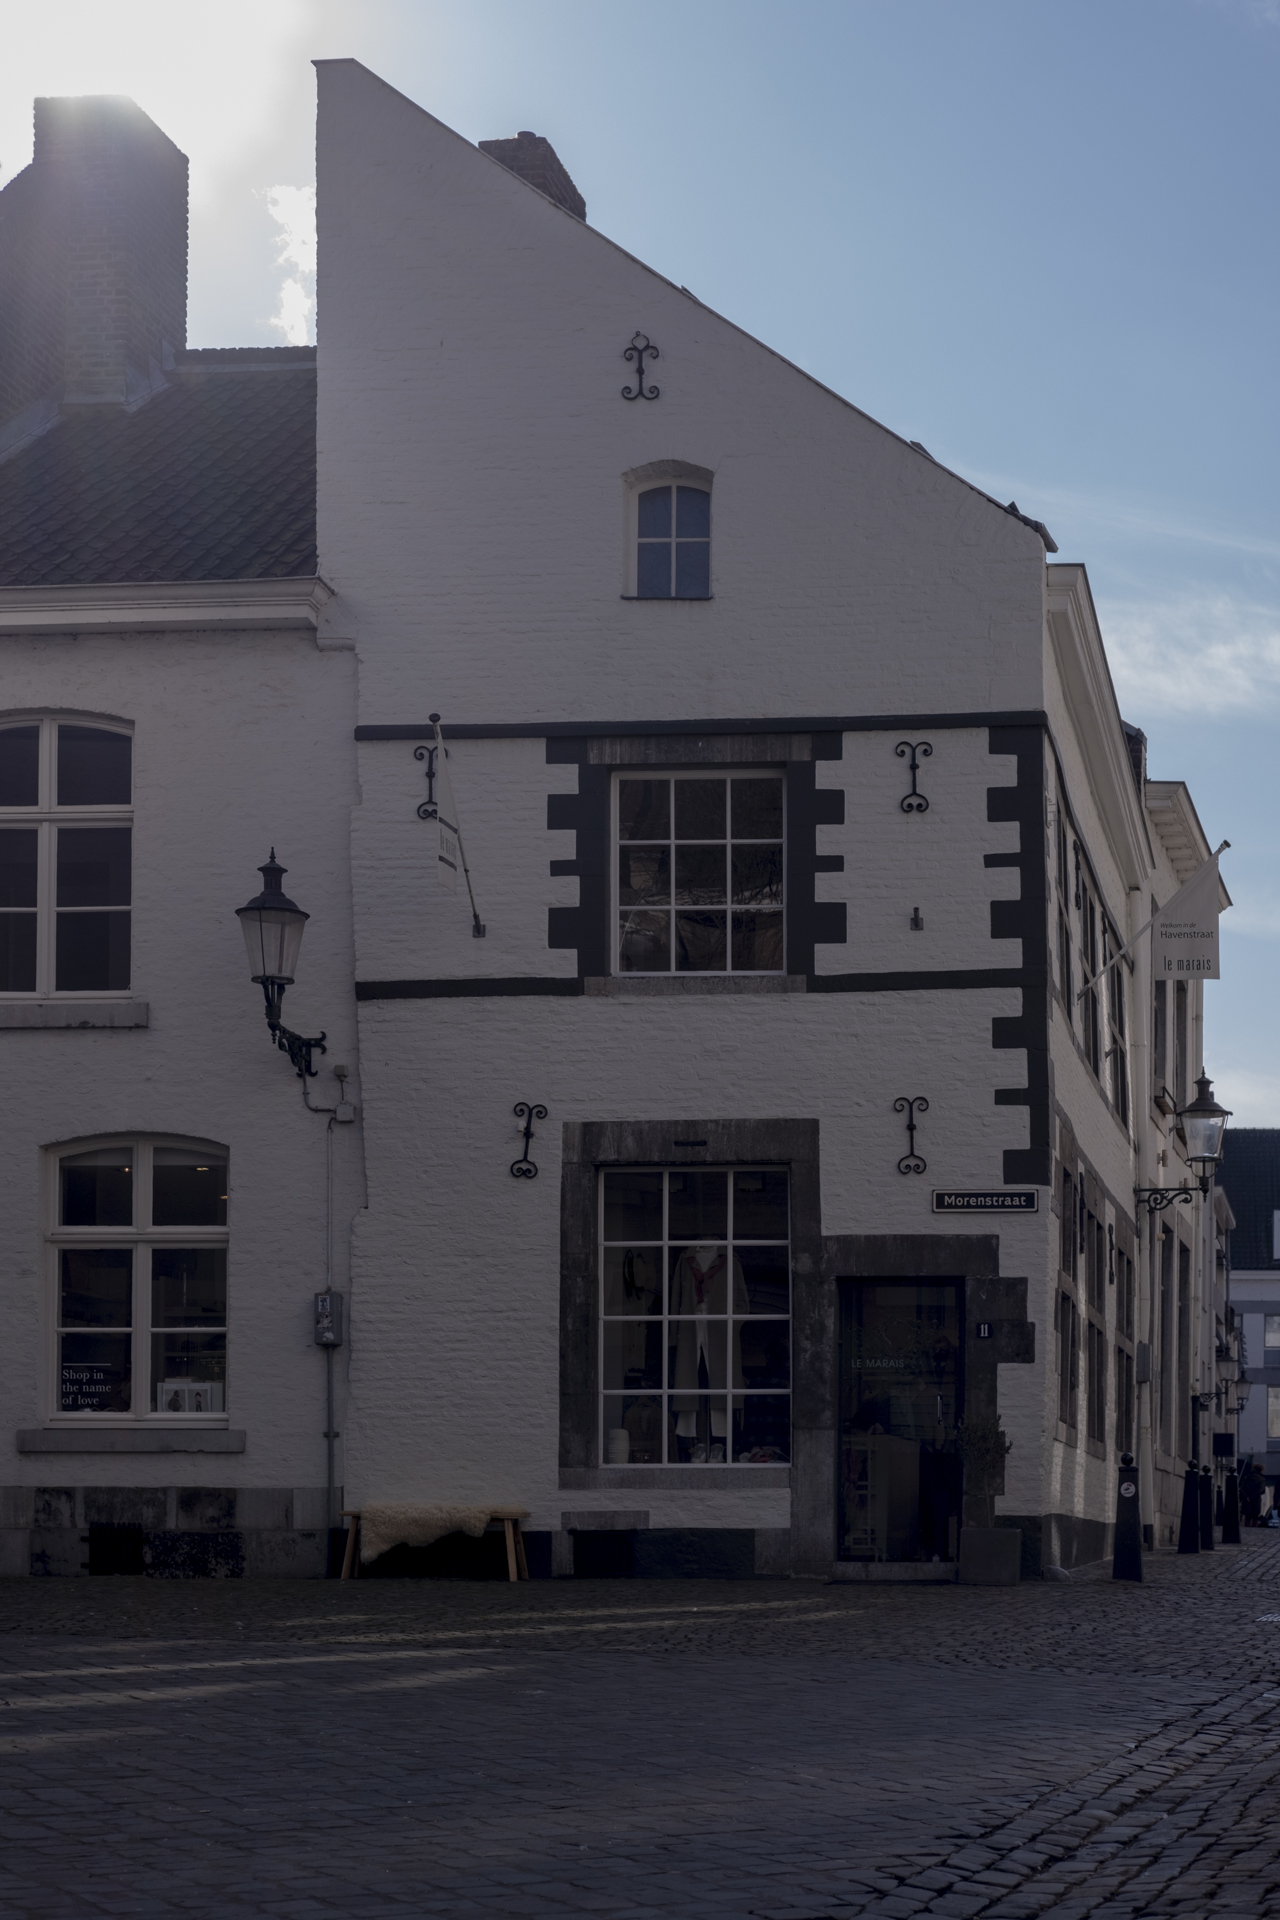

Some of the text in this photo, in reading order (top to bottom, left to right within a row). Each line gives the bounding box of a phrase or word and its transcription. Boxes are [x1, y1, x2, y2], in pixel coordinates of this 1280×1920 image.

[1160, 930, 1214, 939] Havenstraat
[1164, 954, 1211, 971] le marais
[944, 1195, 1027, 1206] Morenstraat
[980, 1324, 989, 1337] 11
[851, 1359, 904, 1368] LE MARAIS
[62, 1369, 104, 1382] Shop in
[62, 1382, 112, 1392] the name
[62, 1395, 99, 1405] of love
